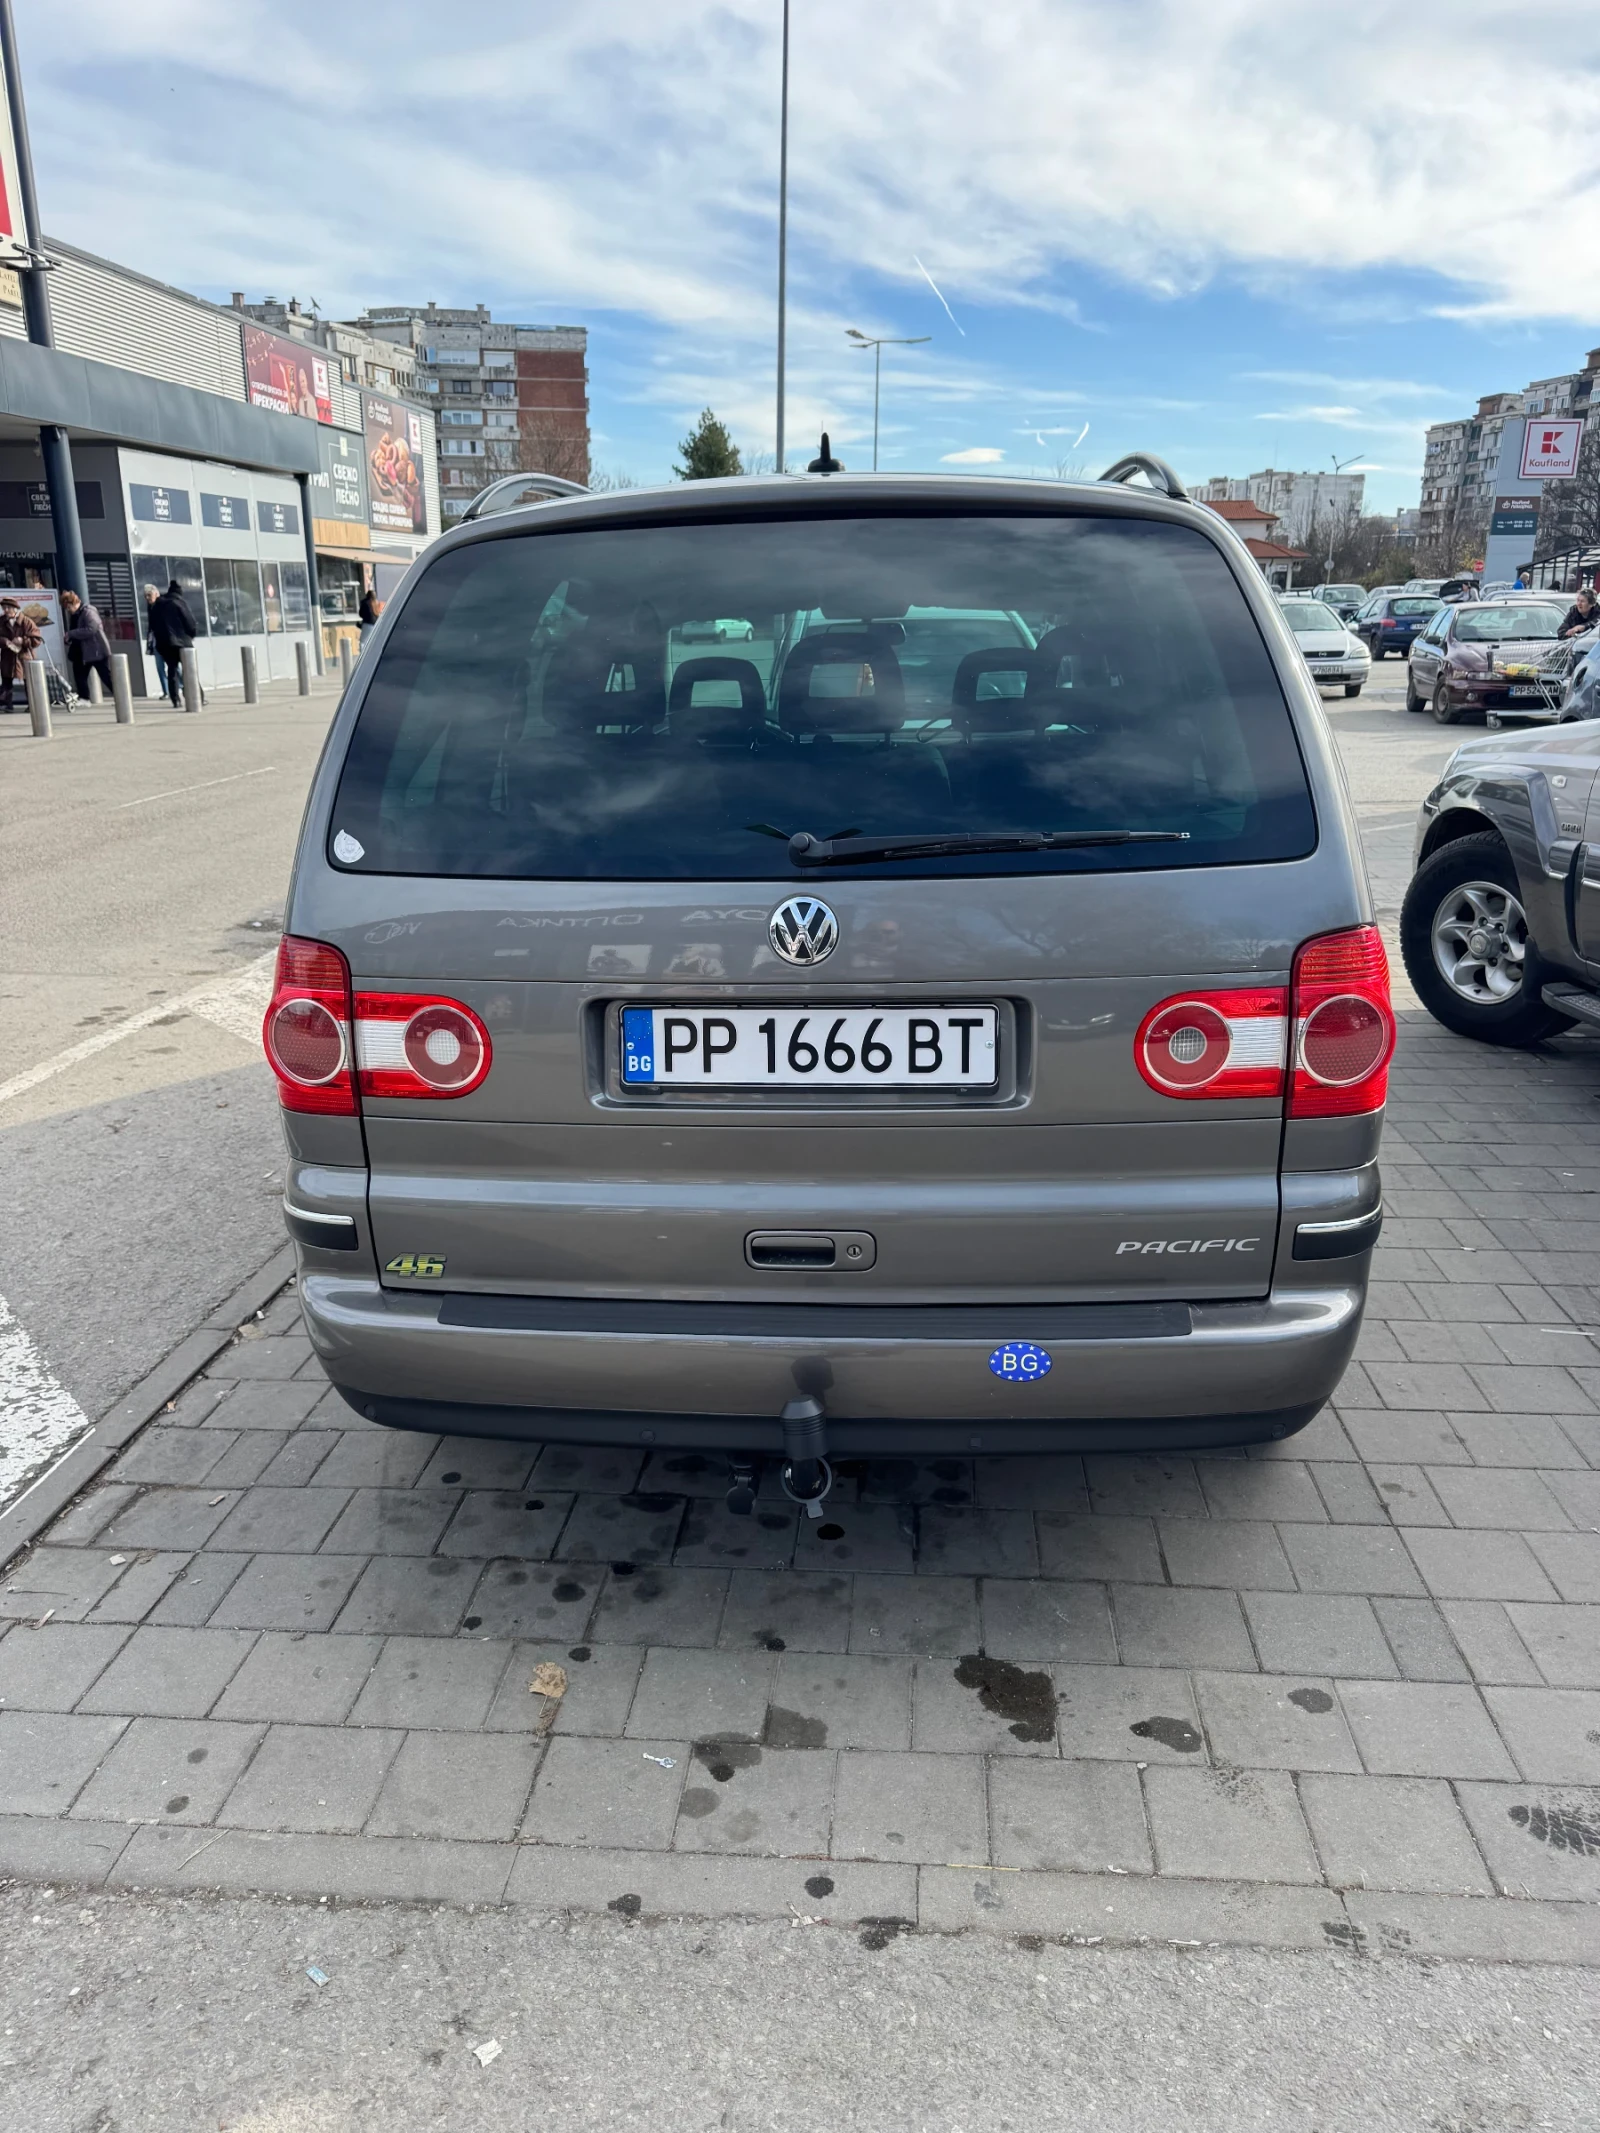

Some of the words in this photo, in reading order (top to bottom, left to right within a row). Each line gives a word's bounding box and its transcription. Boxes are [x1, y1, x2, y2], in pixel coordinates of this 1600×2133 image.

[1529, 459, 1570, 467] Kaufland
[333, 463, 358, 483] СВЕЖО
[663, 1018, 738, 1073] PP
[758, 1018, 893, 1074] 1666
[907, 1018, 984, 1074] BT
[628, 1055, 652, 1073] BG
[1115, 1237, 1261, 1255] PACIFIC
[385, 1252, 447, 1279] 46
[1002, 1353, 1039, 1372] BG
